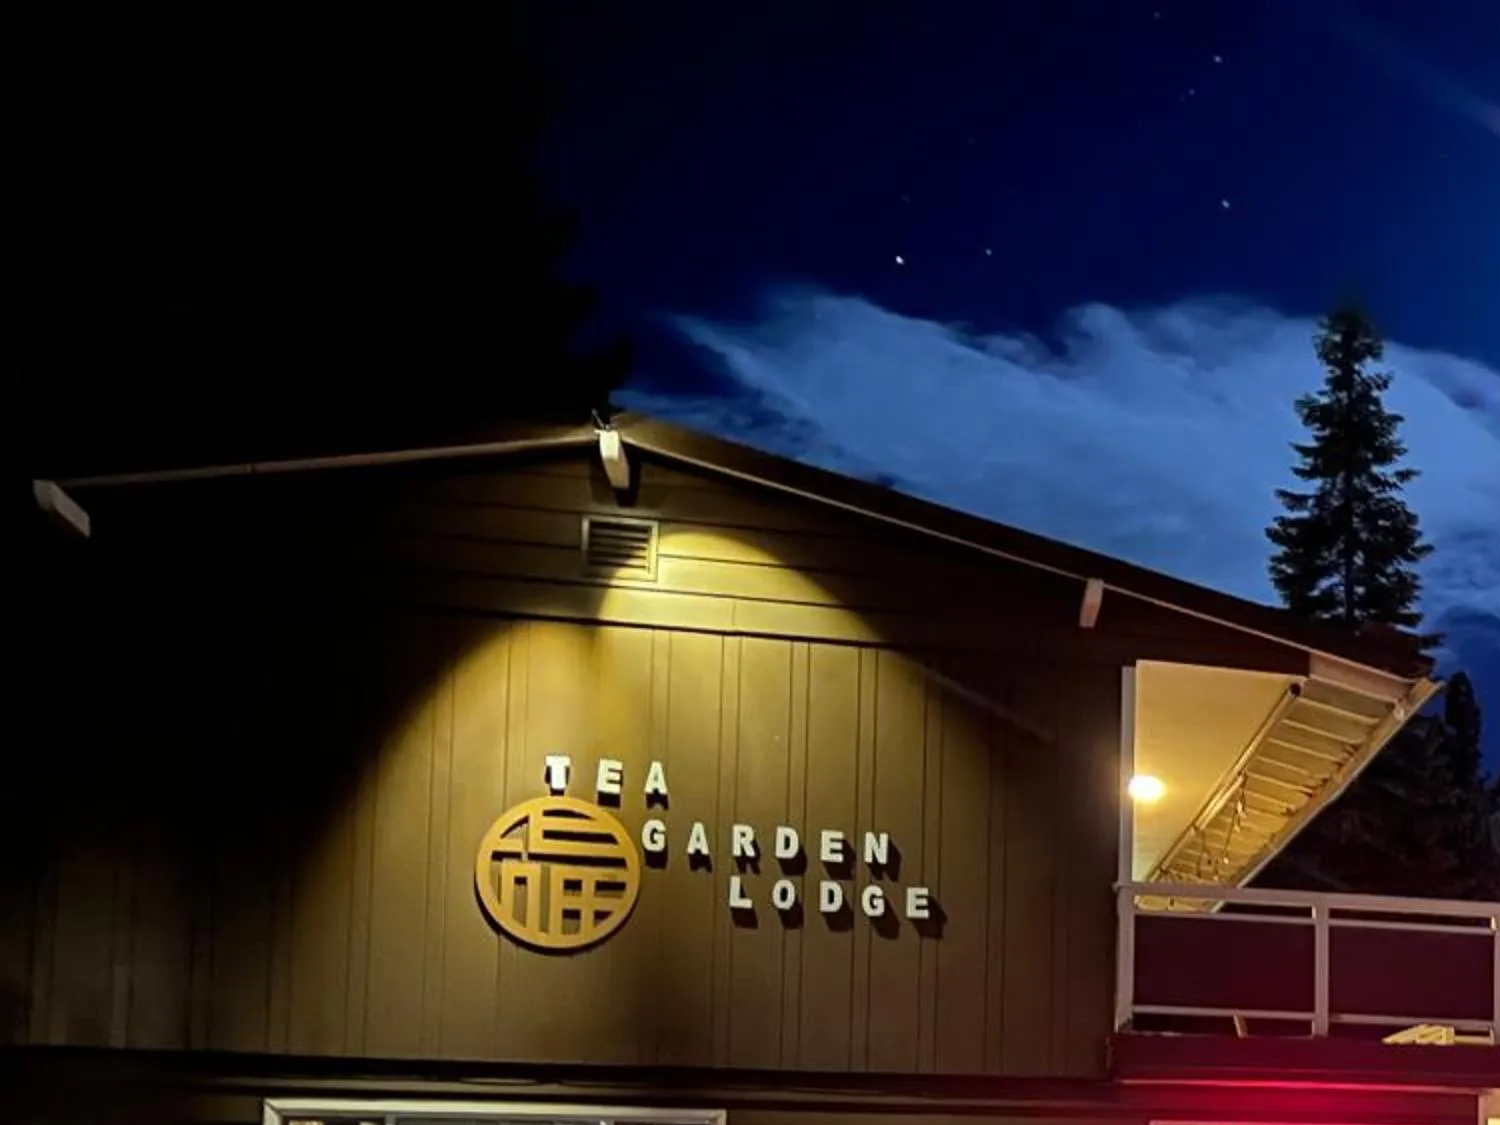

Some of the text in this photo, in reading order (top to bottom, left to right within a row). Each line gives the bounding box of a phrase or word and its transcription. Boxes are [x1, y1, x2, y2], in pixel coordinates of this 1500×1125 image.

[545, 754, 669, 795] TEA
[641, 819, 889, 865] GARDEN
[729, 875, 930, 919] LODGE
